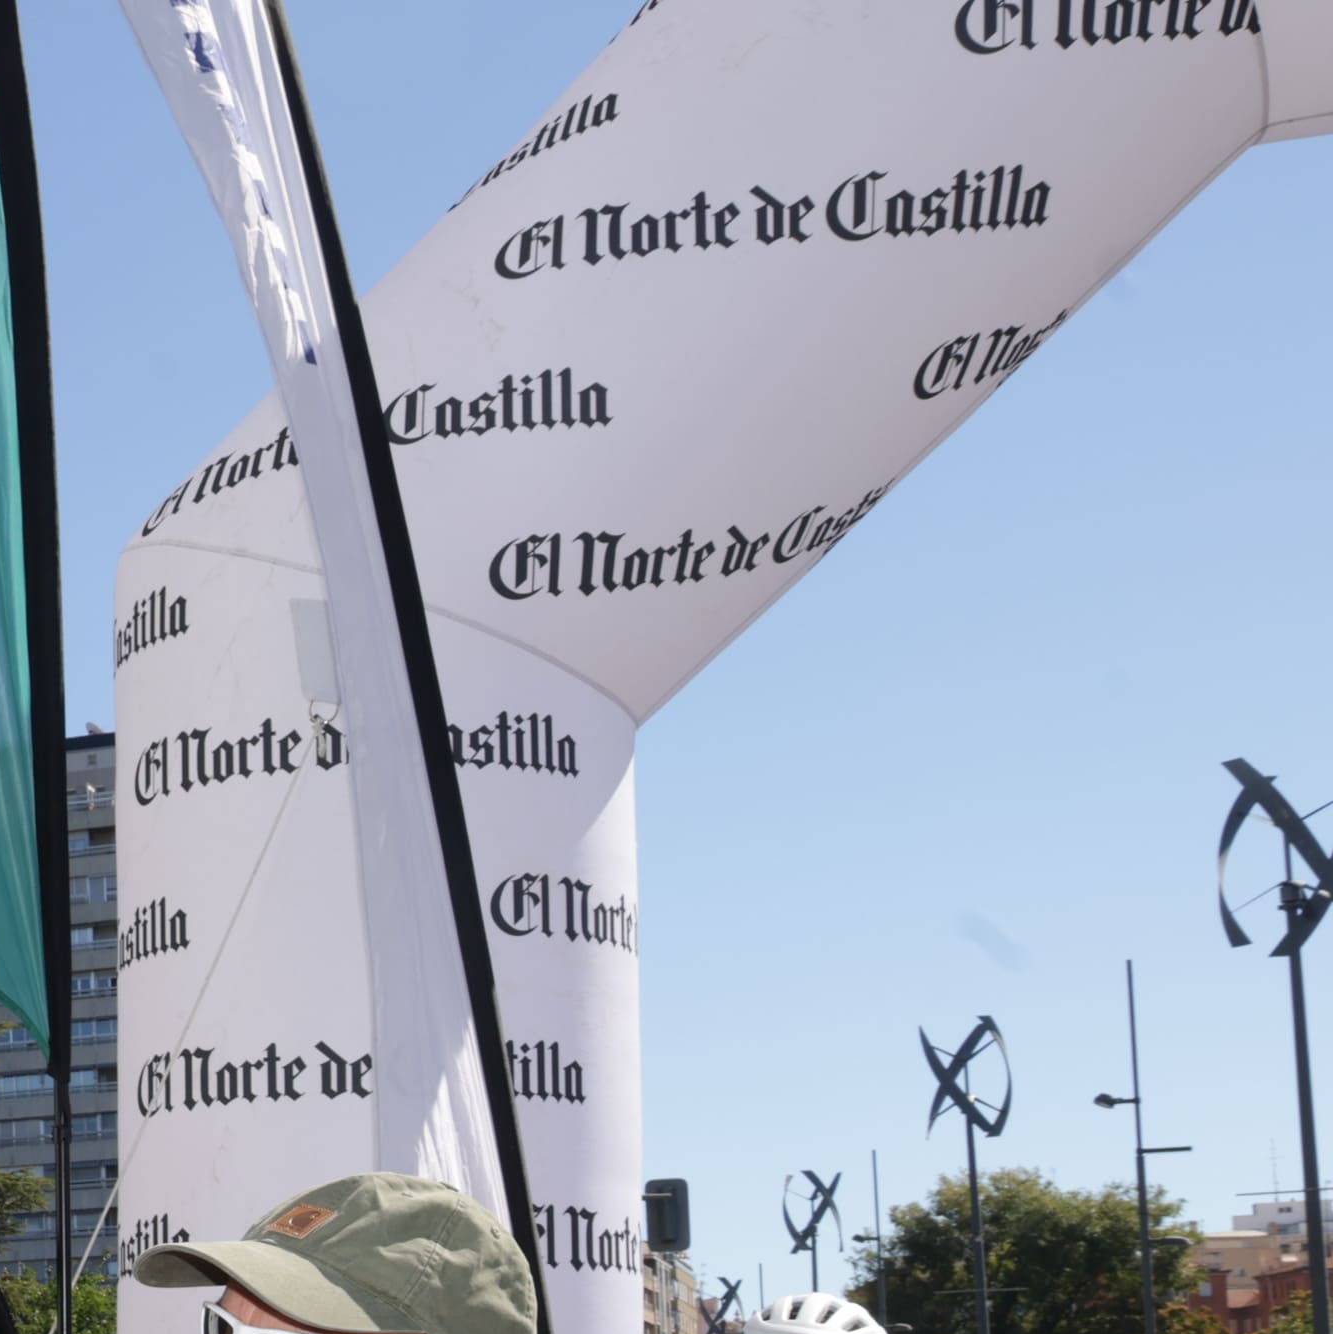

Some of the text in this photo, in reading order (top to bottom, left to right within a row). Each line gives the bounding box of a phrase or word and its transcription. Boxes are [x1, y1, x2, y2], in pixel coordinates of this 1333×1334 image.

[494, 164, 1051, 280] El Norte de Castilla
[913, 332, 981, 400] El
[383, 367, 613, 445] Castilla
[489, 532, 562, 600] El
[573, 529, 716, 598] Norte
[721, 525, 770, 577] de
[134, 728, 171, 806] El
[177, 718, 303, 792] Norte
[445, 711, 580, 778] astilla
[490, 872, 632, 953] El Norte
[137, 1041, 373, 1118] El Norte de
[563, 1205, 637, 1275] Norte
